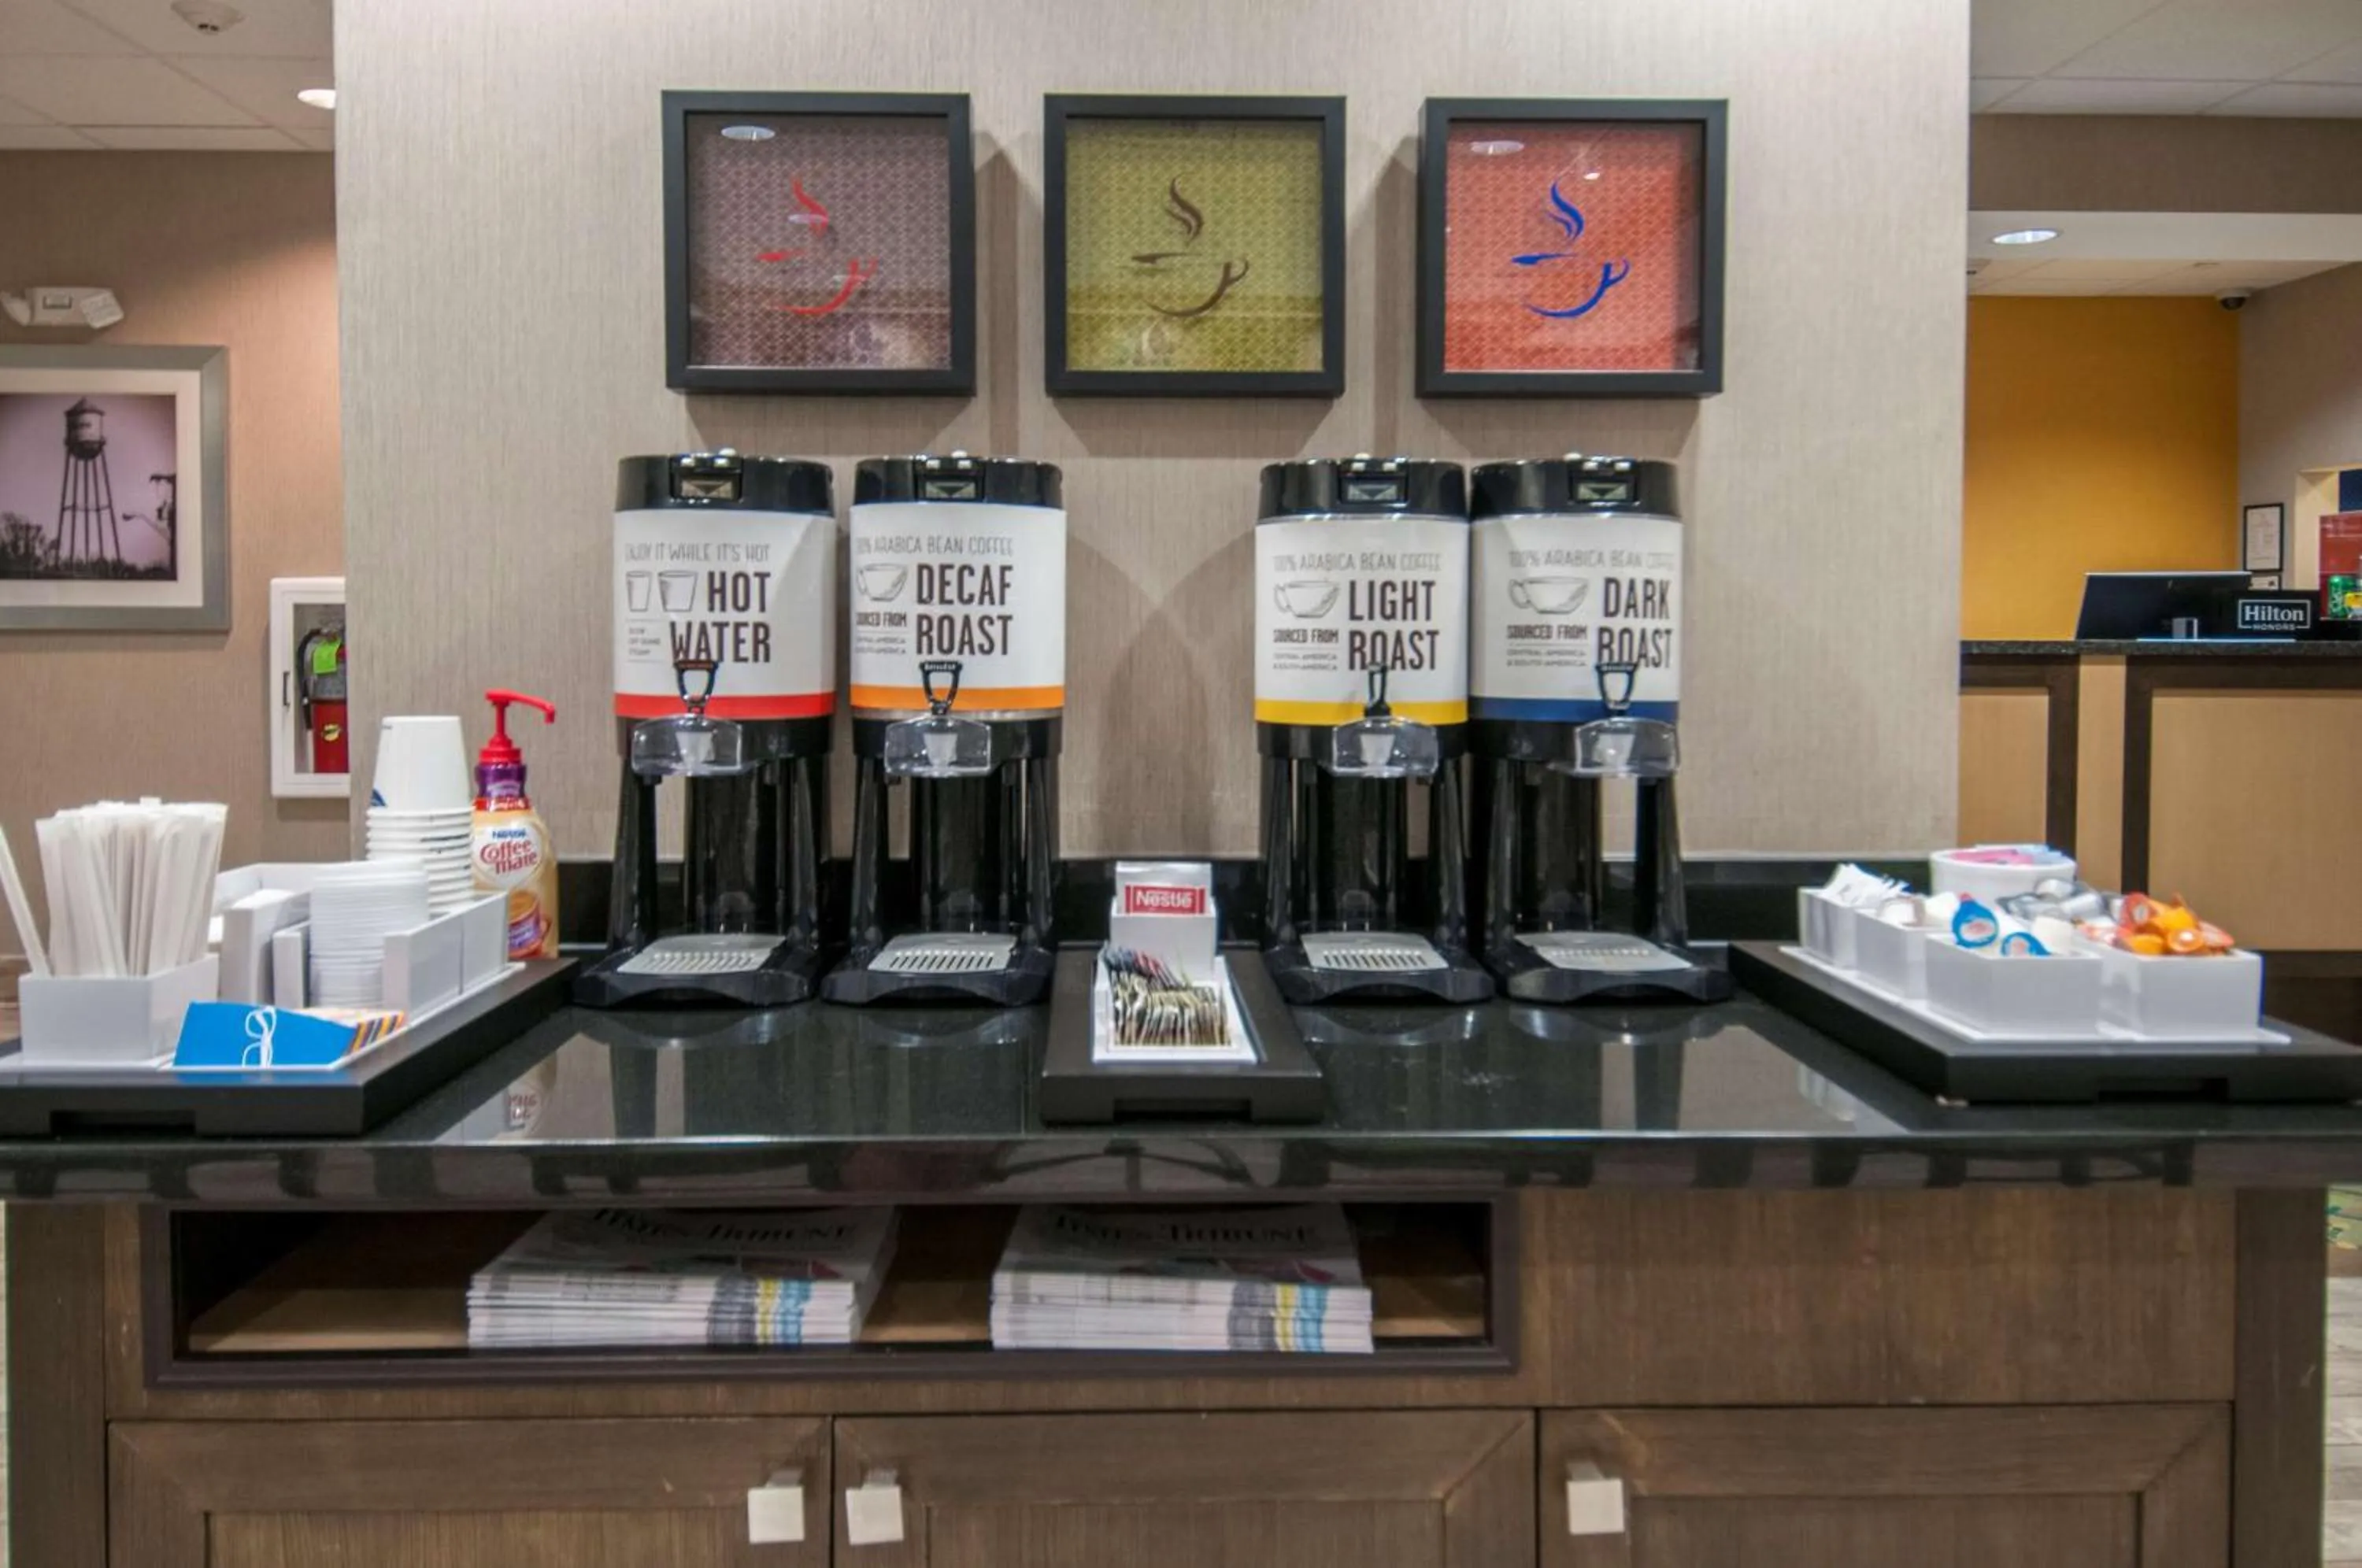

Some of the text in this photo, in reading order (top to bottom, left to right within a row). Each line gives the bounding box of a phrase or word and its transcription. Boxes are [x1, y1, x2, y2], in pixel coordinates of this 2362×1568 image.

[655, 542, 665, 561] IT
[669, 543, 713, 562] WHILE
[717, 543, 741, 562] IT'S
[746, 543, 772, 562] HOT
[875, 536, 922, 554] ARABICA
[927, 536, 963, 554] BEAN
[1300, 553, 1356, 572] ARABICA
[1360, 553, 1397, 571] BEAN
[1543, 549, 1606, 568] ARABICA
[707, 571, 772, 612] HOT
[916, 564, 1014, 606] DECAF
[1348, 580, 1436, 622] LIGHT
[1603, 577, 1671, 619] DARK
[883, 612, 907, 627] FROM
[2244, 605, 2305, 622] Hilton
[669, 621, 772, 663] WATER
[916, 613, 1014, 656] ROAST
[1311, 629, 1339, 643] FROM
[1506, 624, 1588, 640] SOURCED FROM
[1348, 630, 1440, 671] ROAST
[1597, 627, 1675, 669] ROAST
[479, 839, 532, 865] Coffee
[494, 851, 538, 875] mate
